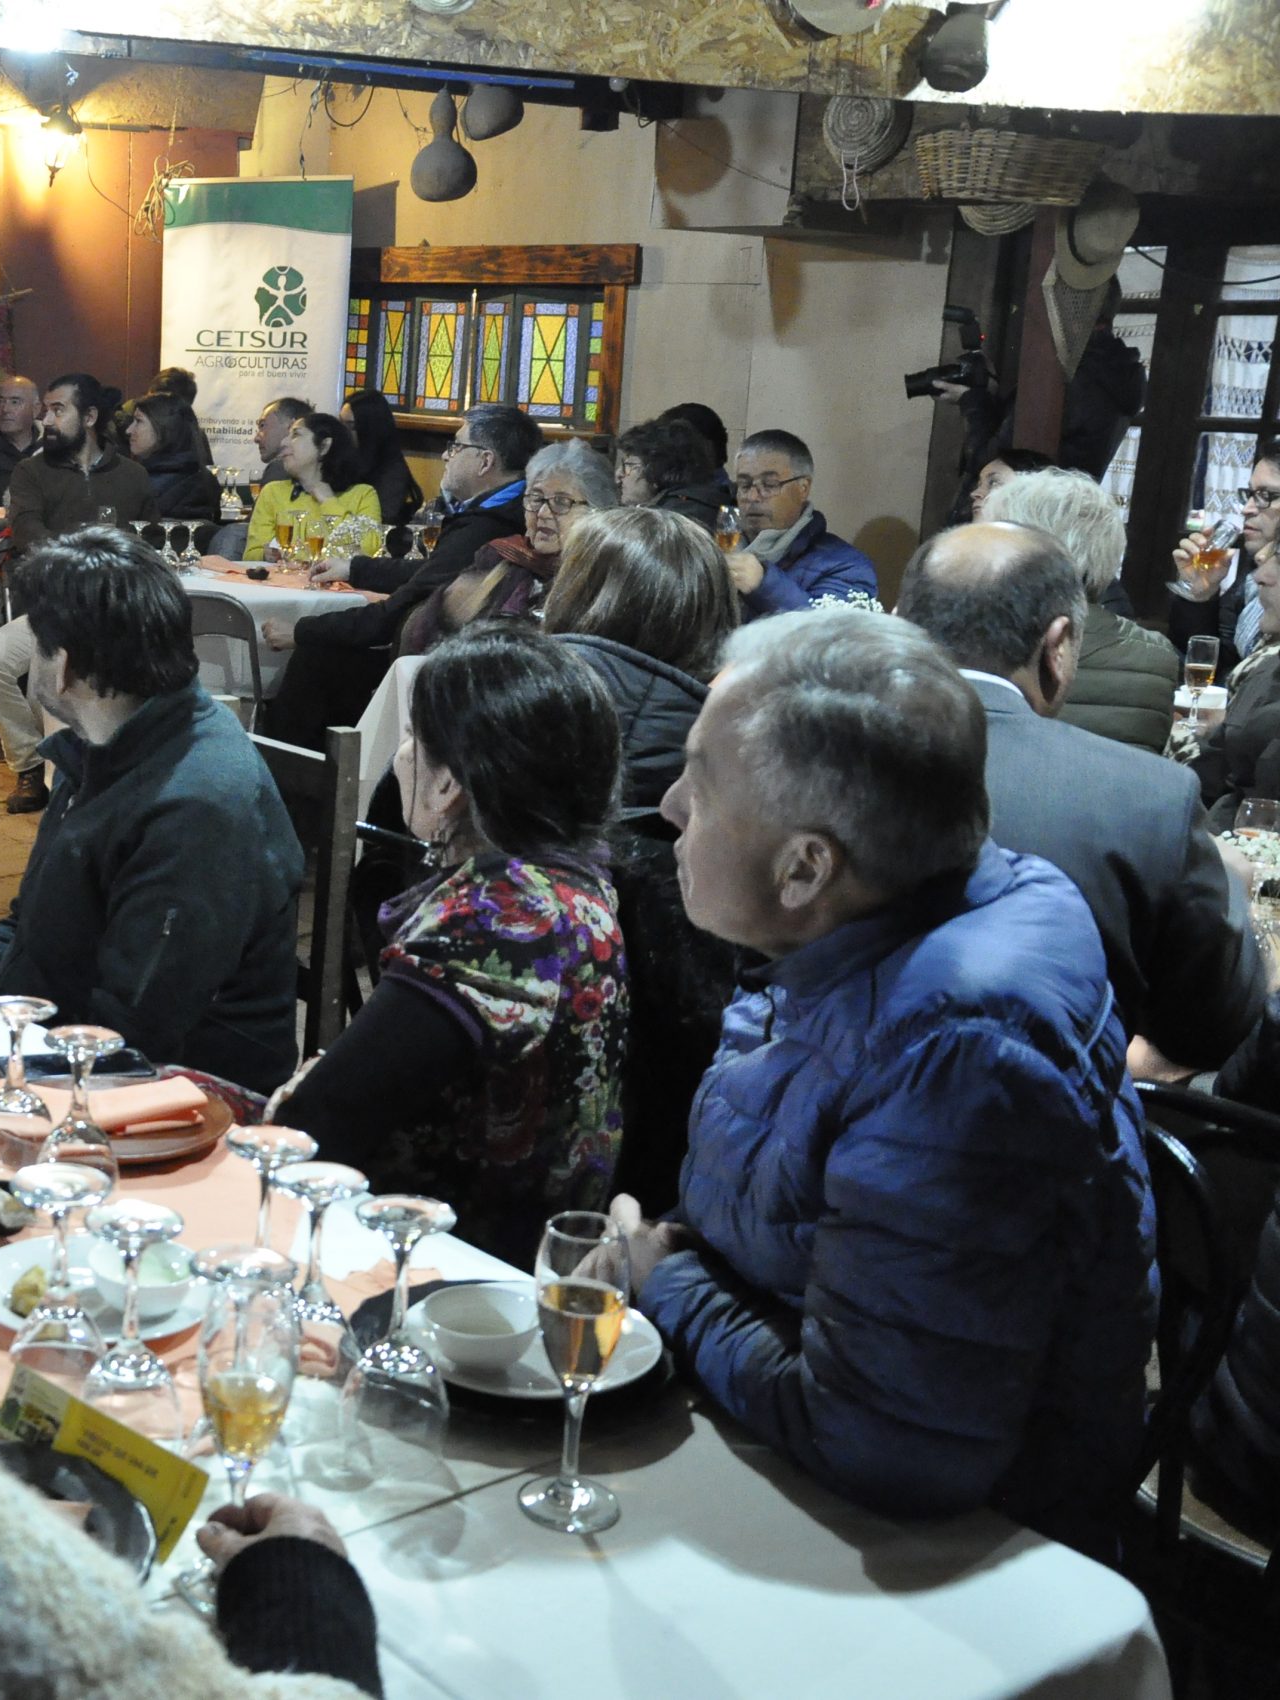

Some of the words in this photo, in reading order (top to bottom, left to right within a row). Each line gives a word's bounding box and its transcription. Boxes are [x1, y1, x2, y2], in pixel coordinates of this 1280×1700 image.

[196, 329, 308, 349] CETSUR
[195, 355, 308, 370] AGROCULTURAS
[238, 371, 256, 379] para
[198, 417, 239, 425] tribuyendo
[205, 426, 253, 435] ntabilidad
